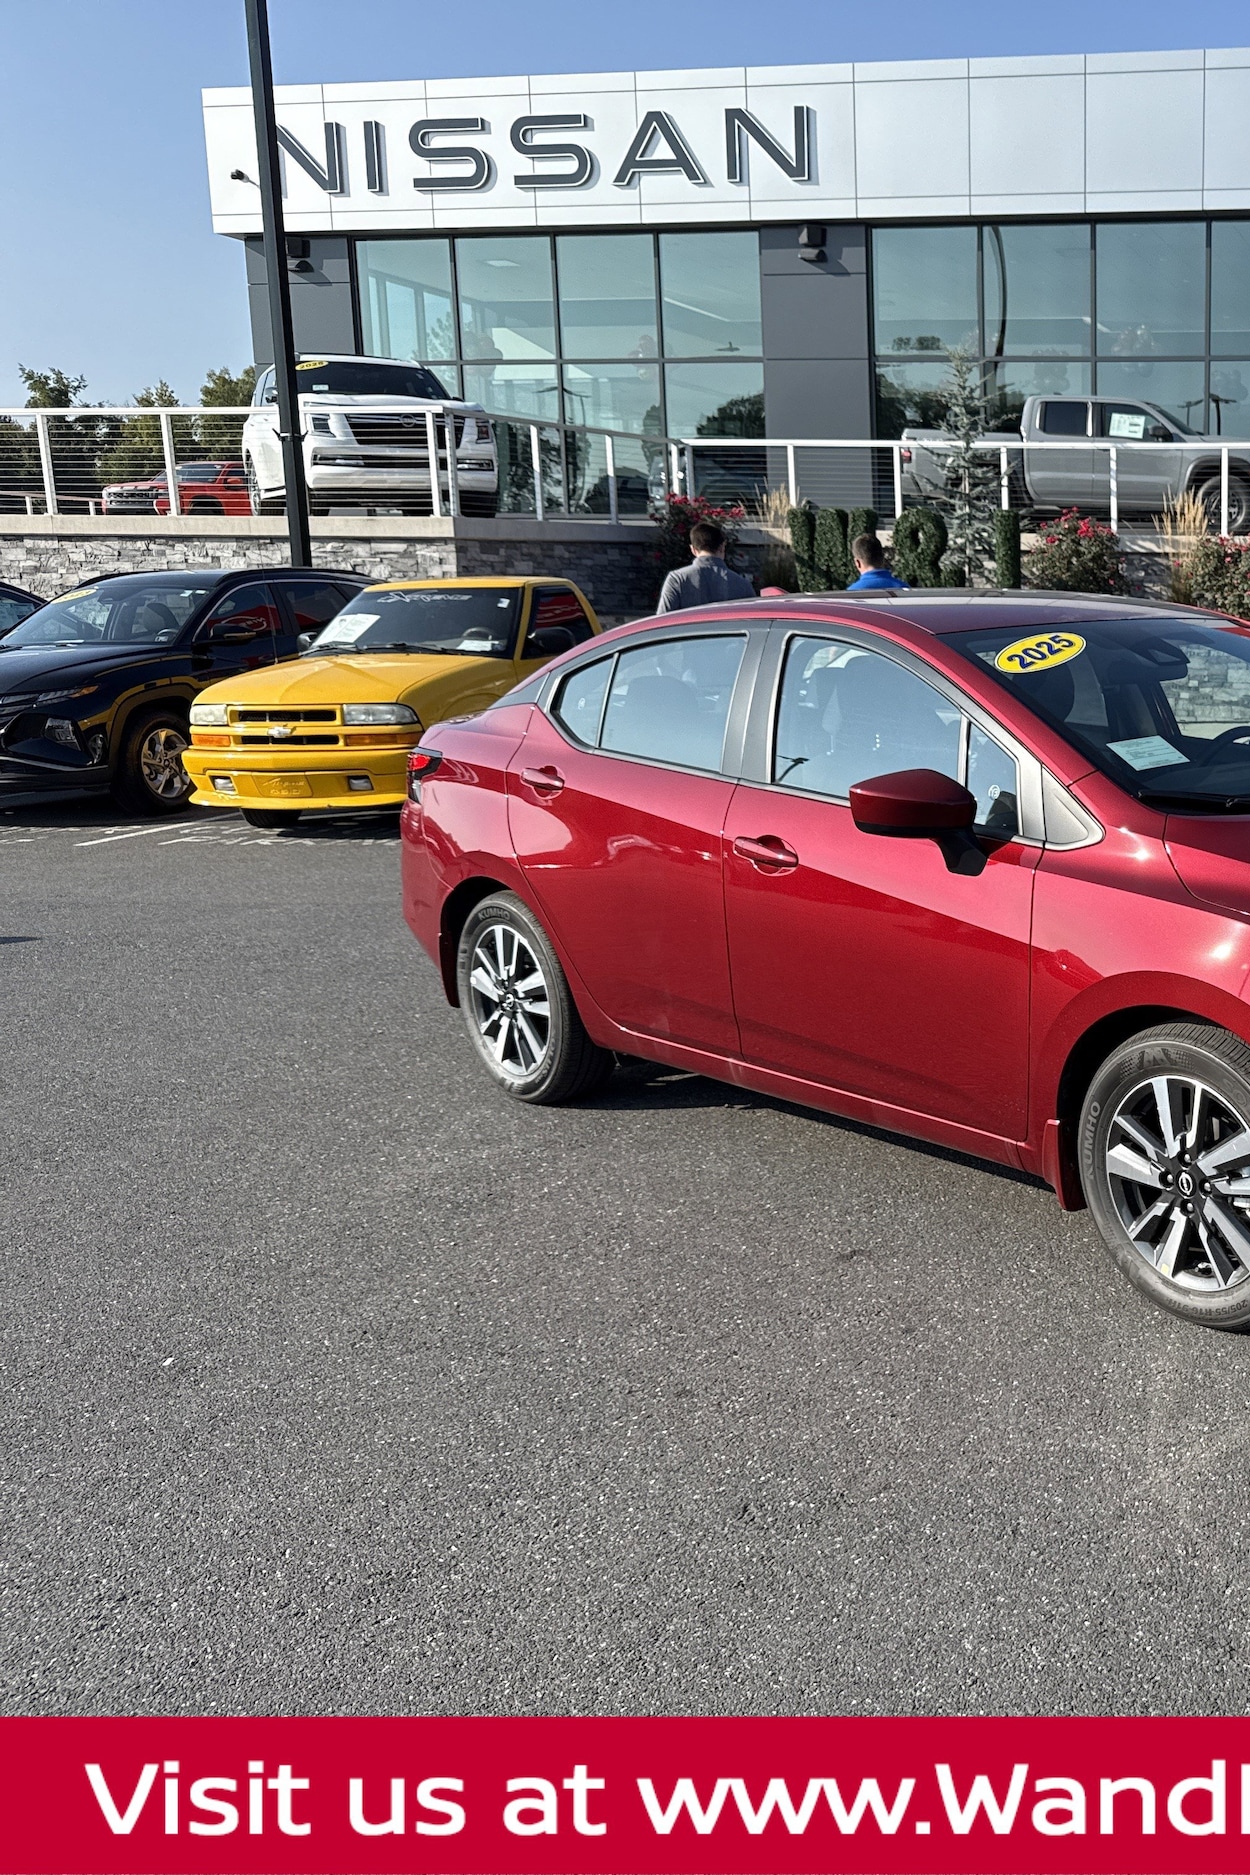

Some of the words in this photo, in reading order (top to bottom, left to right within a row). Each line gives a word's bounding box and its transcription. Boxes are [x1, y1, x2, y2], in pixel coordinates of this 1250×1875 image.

[276, 105, 810, 194] NISSAN
[1007, 635, 1074, 669] 2025
[478, 908, 511, 921] KUMHO
[1082, 1100, 1101, 1181] KUMHO
